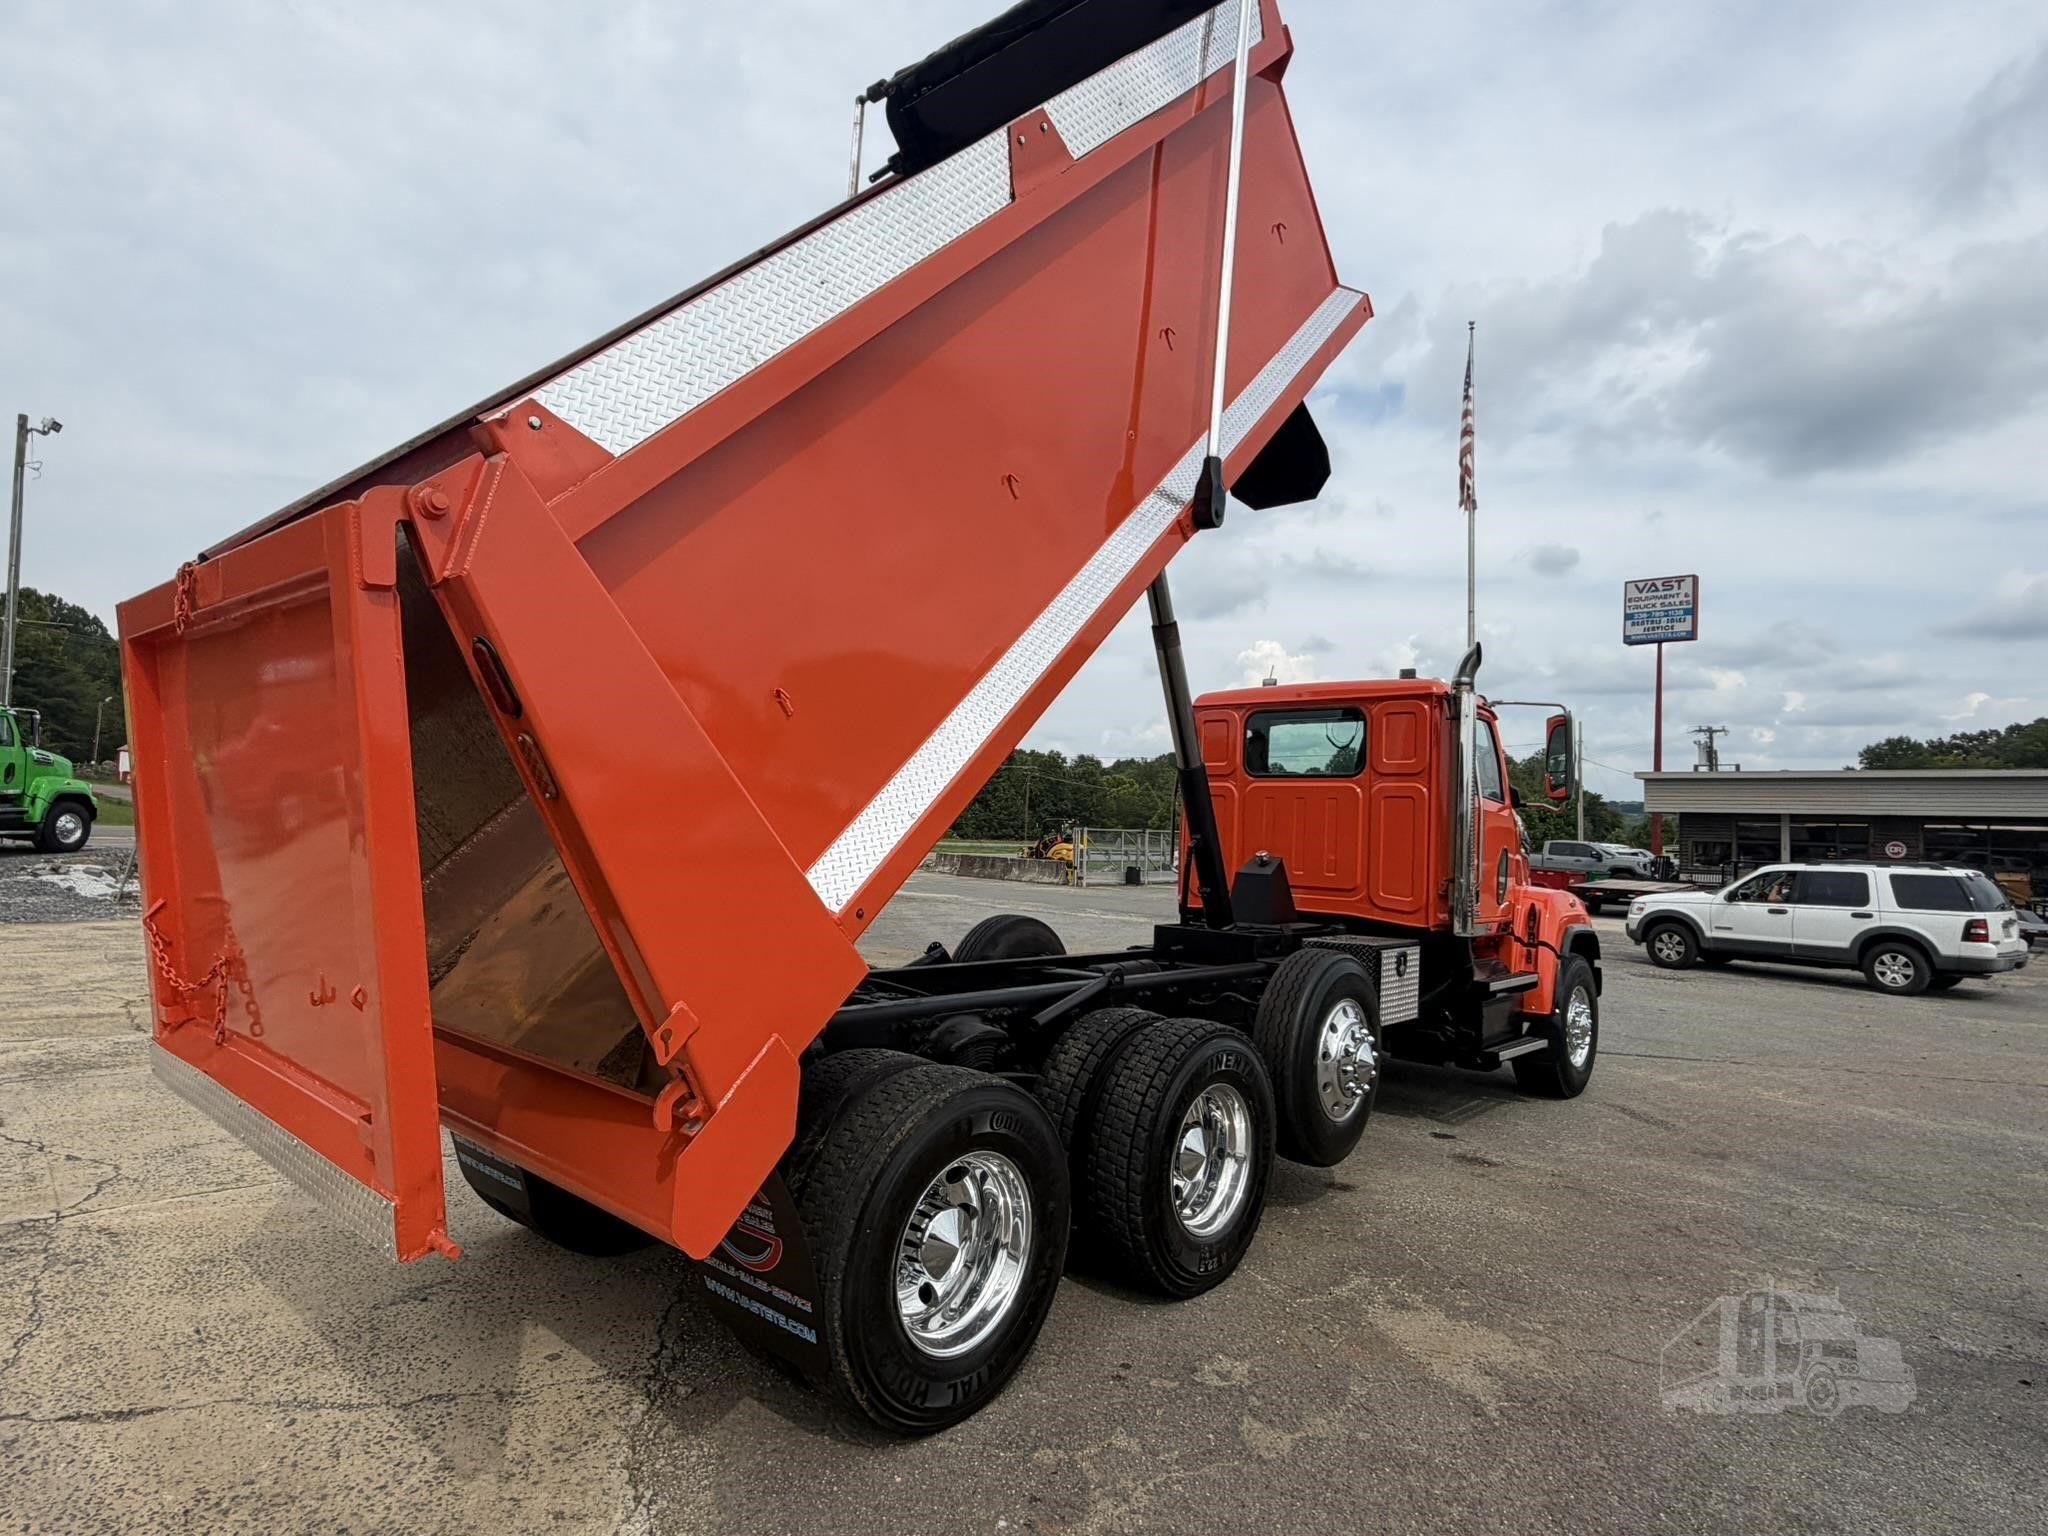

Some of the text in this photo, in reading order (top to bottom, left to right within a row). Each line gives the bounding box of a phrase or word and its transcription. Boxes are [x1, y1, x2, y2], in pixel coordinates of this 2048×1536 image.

[1634, 579, 1686, 594] VAST
[1628, 593, 1681, 603] EQUIPMENT
[1627, 600, 1691, 611] TRUCK SALES
[1642, 624, 1675, 632] SERVICE
